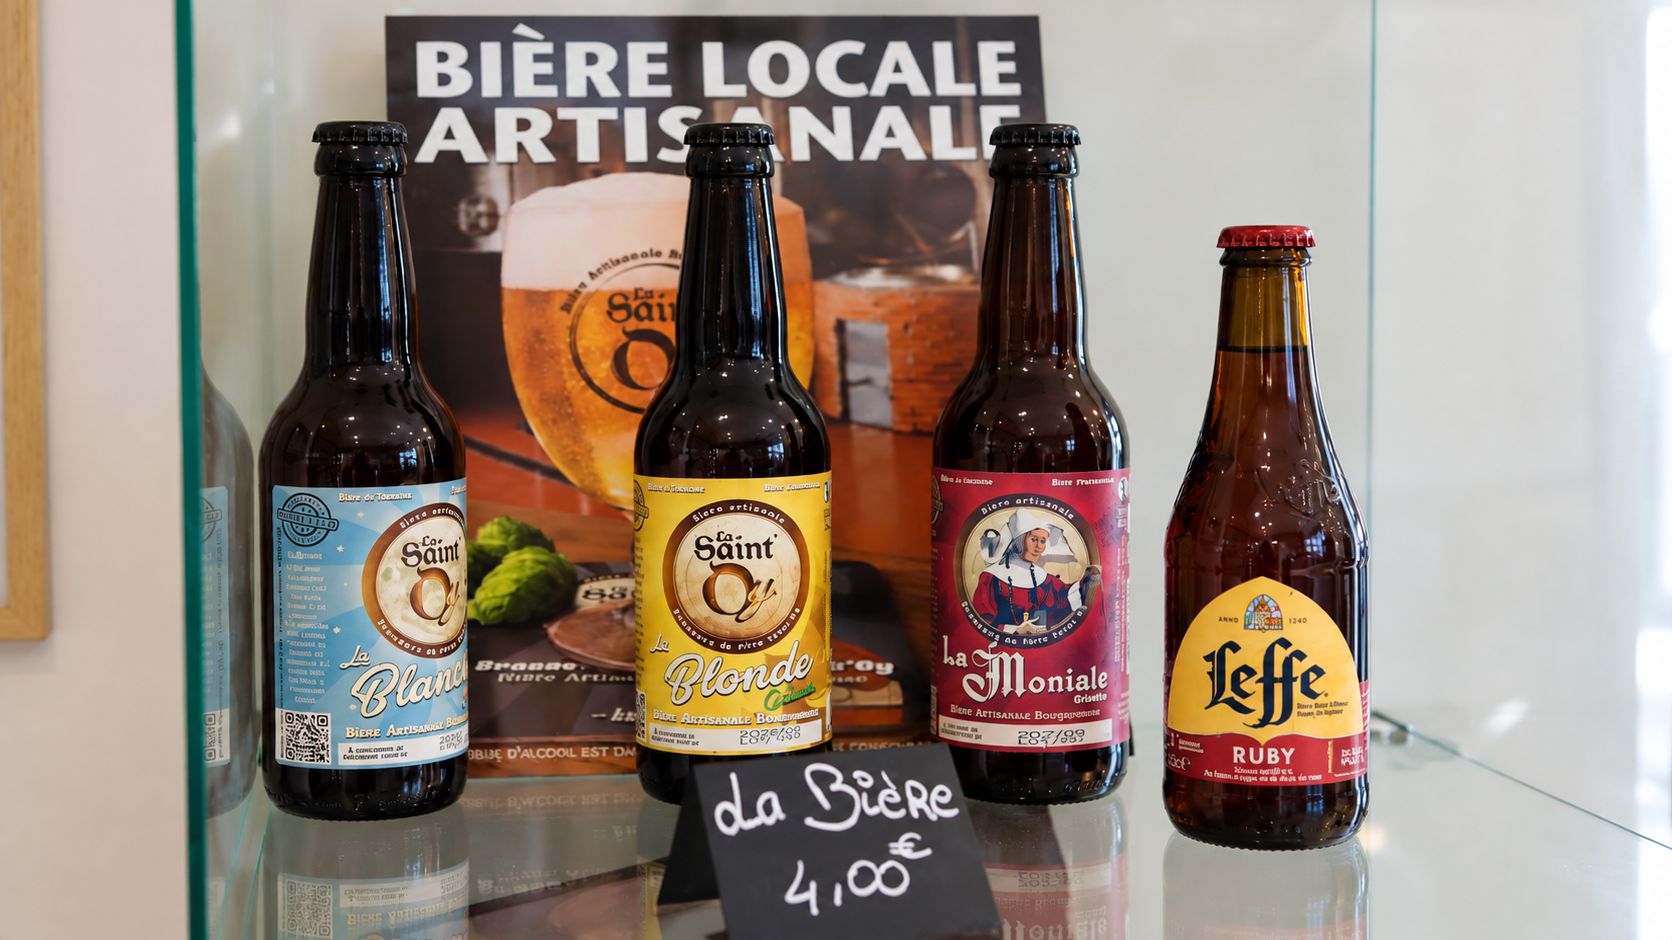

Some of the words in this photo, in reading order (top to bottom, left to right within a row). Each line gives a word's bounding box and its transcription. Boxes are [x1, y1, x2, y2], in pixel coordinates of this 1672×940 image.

[416, 22, 673, 98] BIÈRE
[702, 39, 1022, 98] LOCALE
[1218, 616, 1239, 624] ANNO
[1288, 616, 1308, 625] 1240
[650, 632, 669, 653] La
[338, 645, 371, 670] La
[943, 635, 968, 669] La
[962, 641, 1109, 703] Moniale
[664, 640, 815, 706] Blonde
[1202, 636, 1327, 729] Leffe
[581, 746, 609, 758] EST
[1232, 746, 1296, 766] RUBY
